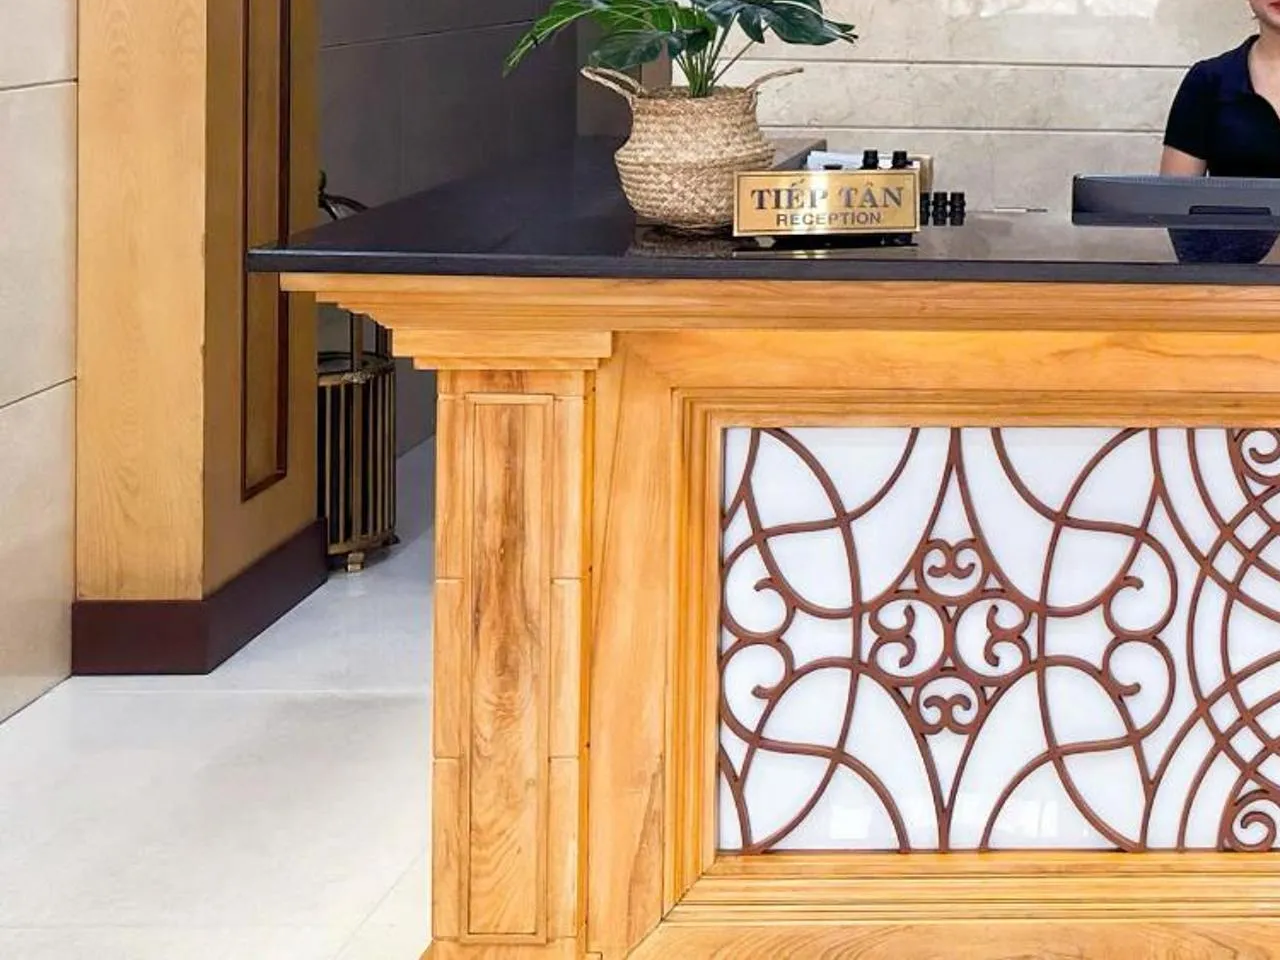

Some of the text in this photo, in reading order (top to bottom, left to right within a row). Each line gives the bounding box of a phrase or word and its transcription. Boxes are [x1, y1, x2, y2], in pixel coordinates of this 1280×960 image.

[750, 177, 905, 210] TIẾP TÂN
[775, 211, 883, 227] RECEPTION
